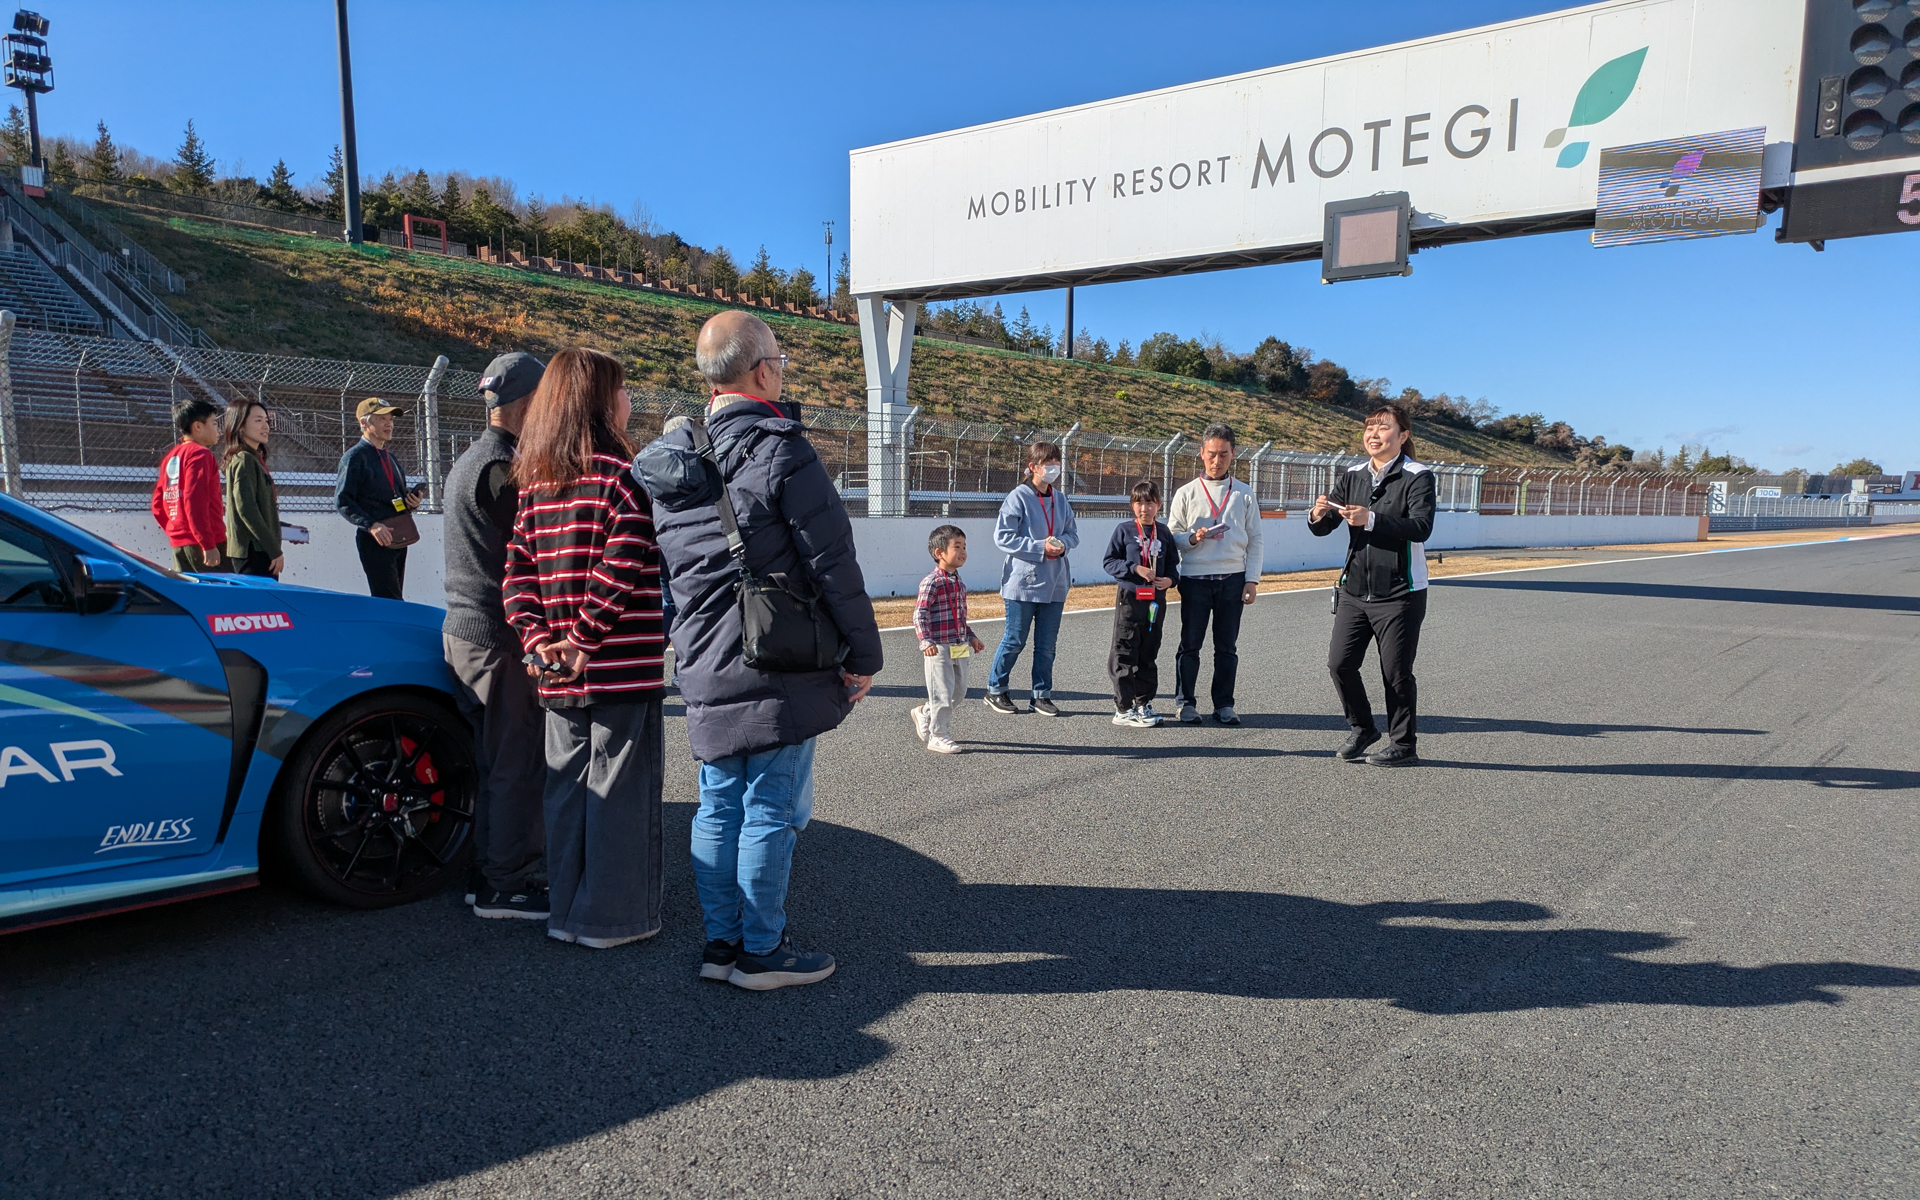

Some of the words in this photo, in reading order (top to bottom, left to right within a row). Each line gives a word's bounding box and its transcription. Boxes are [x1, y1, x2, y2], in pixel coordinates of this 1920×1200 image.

[967, 177, 1097, 220] MOBILITY
[1112, 156, 1231, 198] RESORT
[1251, 98, 1519, 189] MOTEGI
[215, 614, 290, 632] MOTUL
[100, 817, 195, 846] ENDLESS
